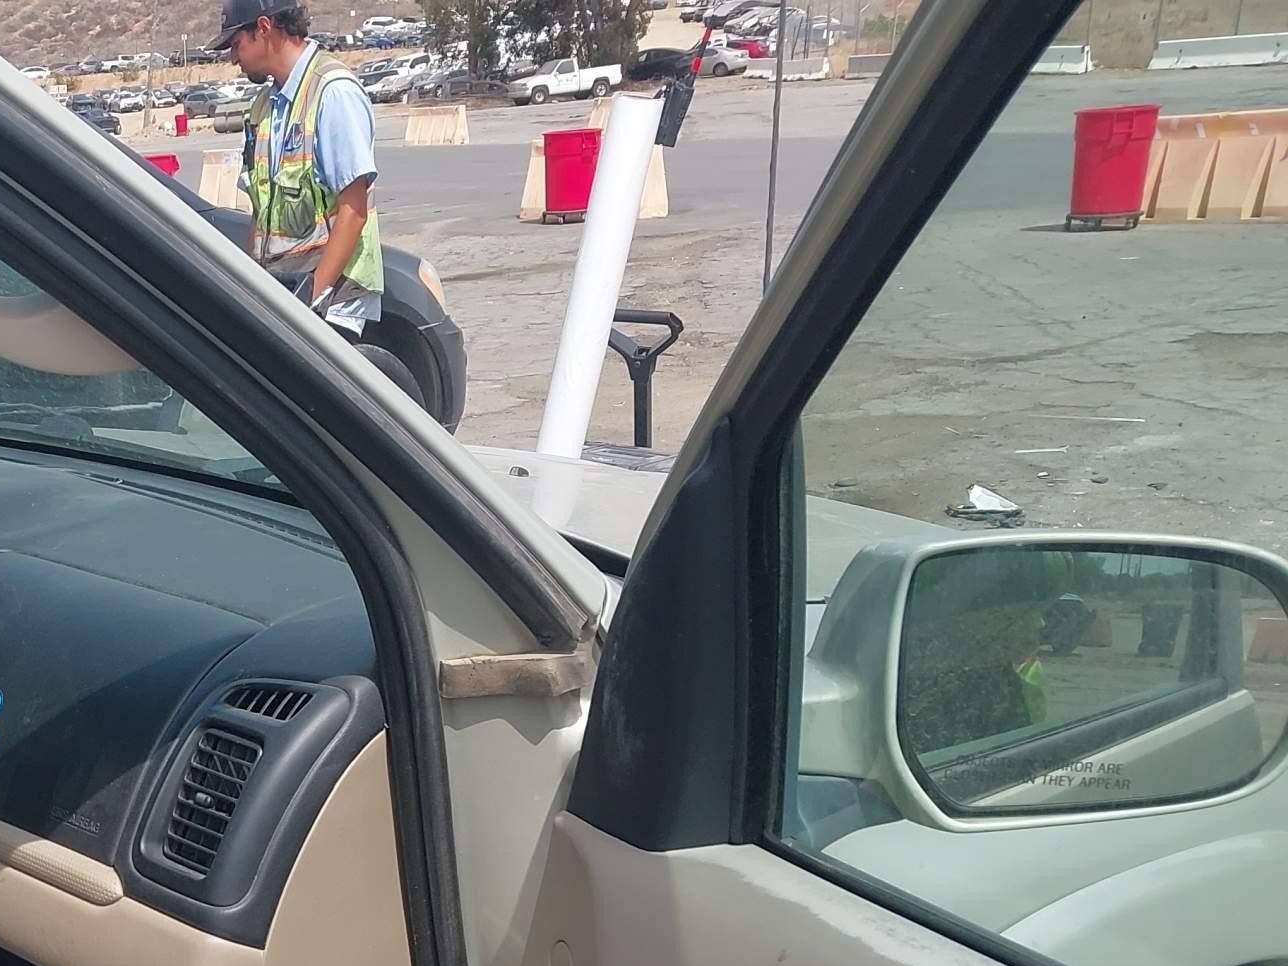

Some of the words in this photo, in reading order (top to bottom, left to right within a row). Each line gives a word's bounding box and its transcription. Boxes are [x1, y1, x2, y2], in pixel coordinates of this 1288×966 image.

[1097, 762, 1124, 776] ARE
[1042, 775, 1074, 787] THEY
[1079, 776, 1131, 791] APPEAR
